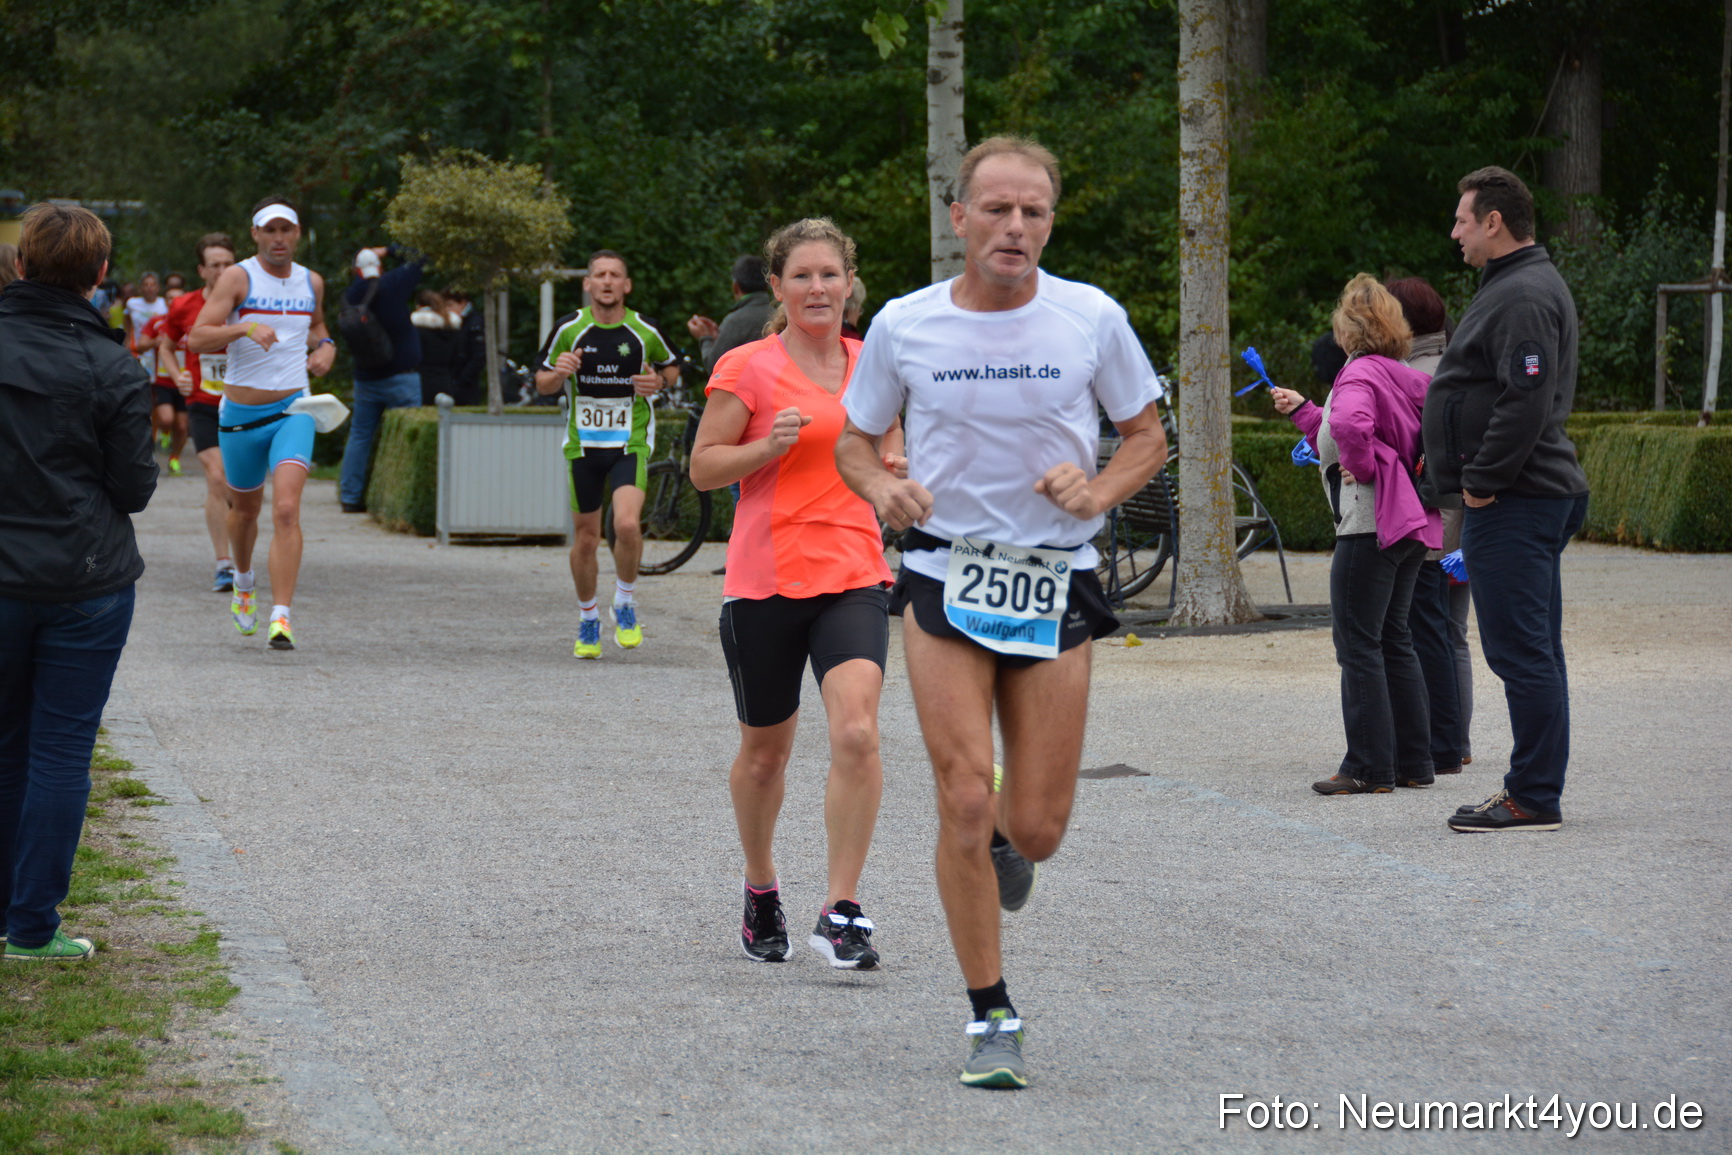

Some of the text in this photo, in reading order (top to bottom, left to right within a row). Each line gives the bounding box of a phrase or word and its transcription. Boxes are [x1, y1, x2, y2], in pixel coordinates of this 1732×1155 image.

[597, 365, 619, 373] DAV
[932, 364, 1061, 382] www.hasit.de
[581, 408, 627, 427] 3014
[957, 563, 1057, 614] 2509
[966, 615, 1035, 642] Wolfgang
